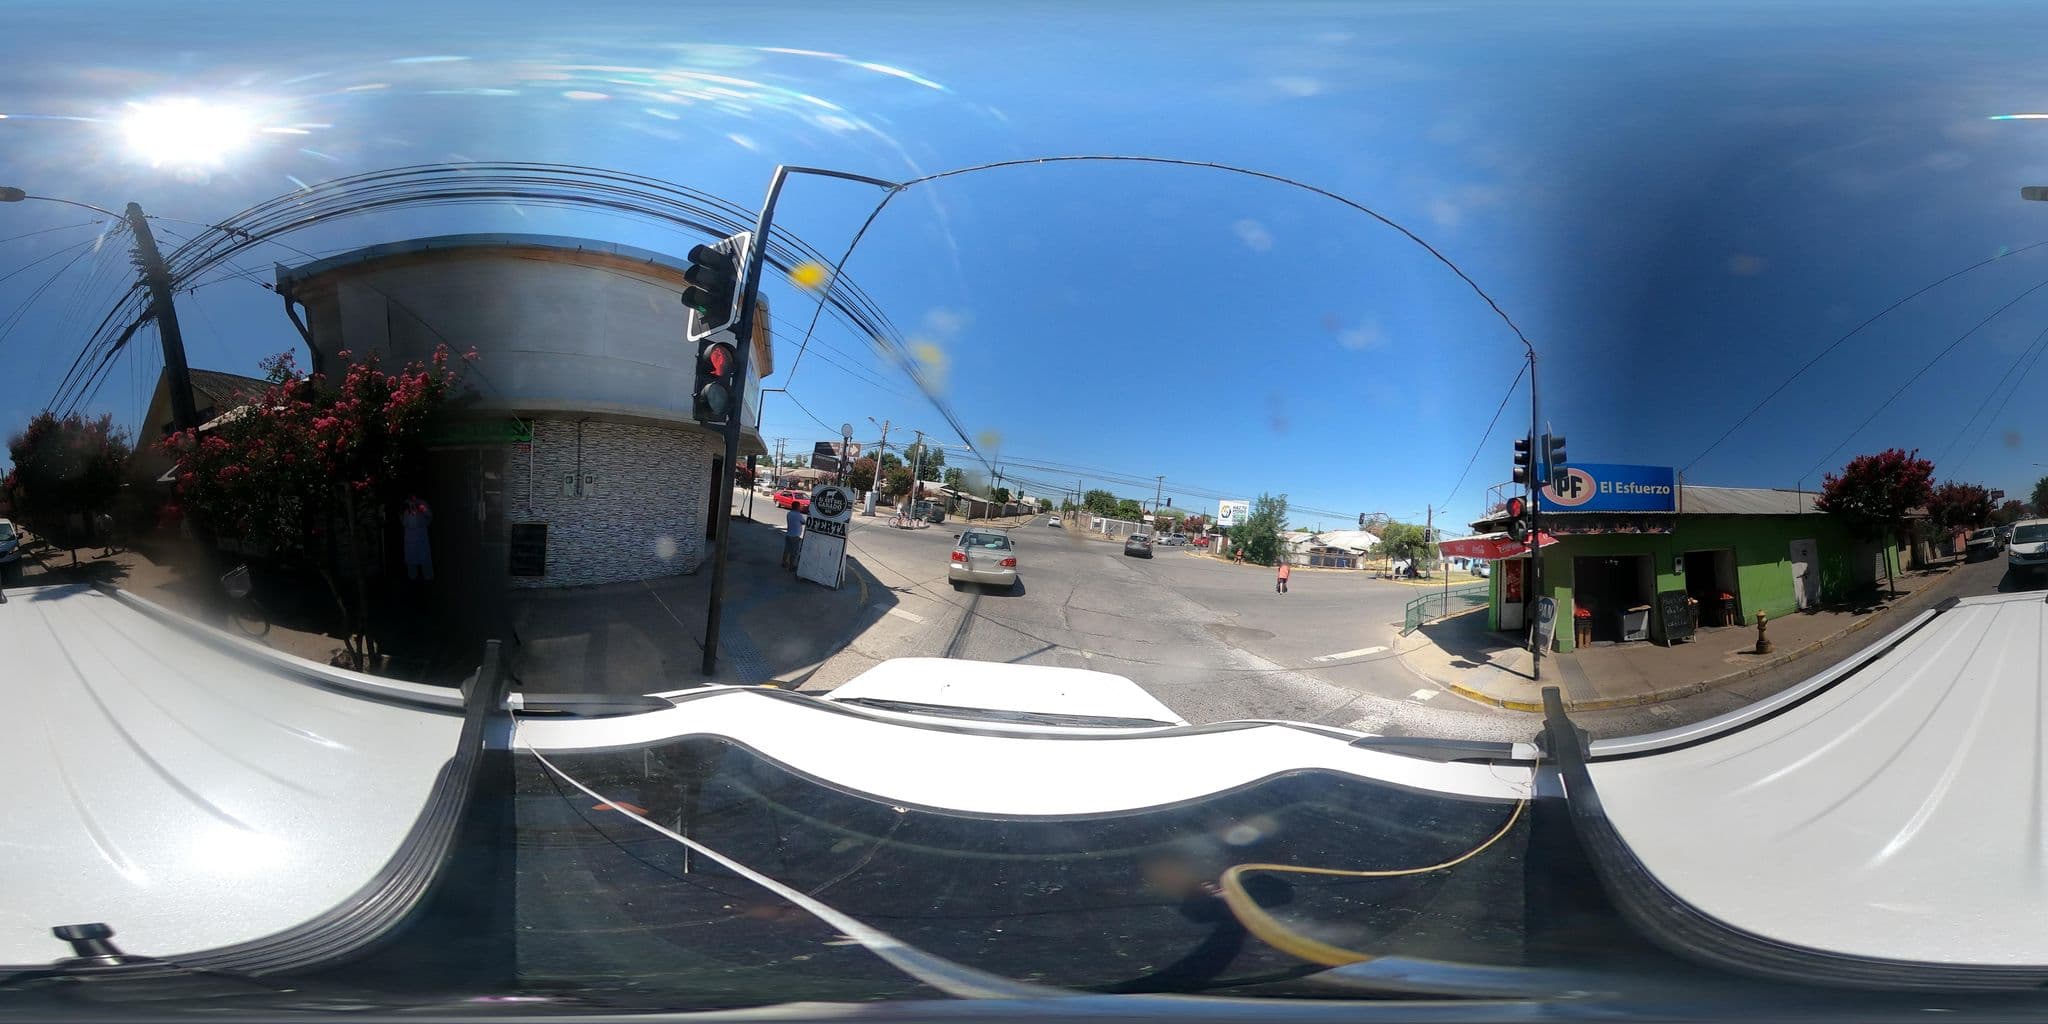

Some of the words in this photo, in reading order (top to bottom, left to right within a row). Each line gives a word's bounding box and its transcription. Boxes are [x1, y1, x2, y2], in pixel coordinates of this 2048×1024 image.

[1600, 481, 1612, 494] El
[1615, 482, 1671, 495] Esfuerzo
[806, 516, 846, 536] OFERTA
[1538, 602, 1554, 618] PAN
